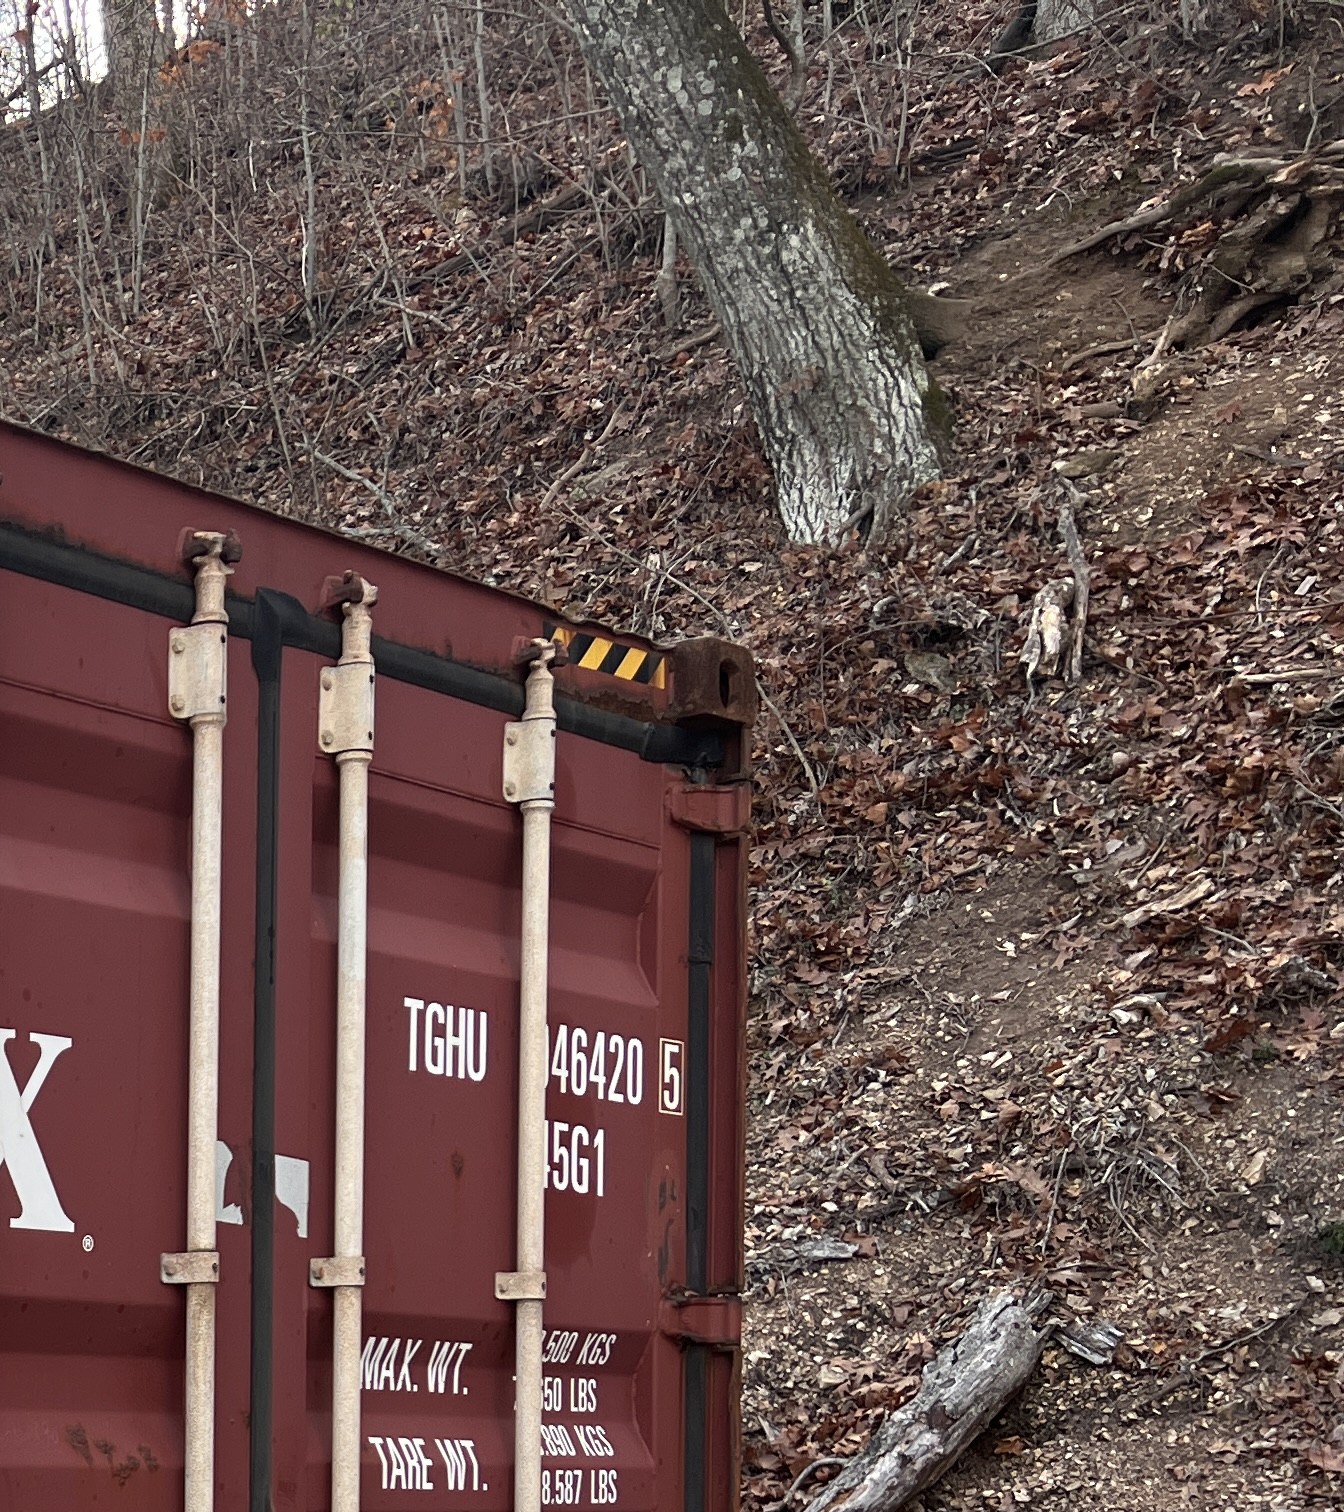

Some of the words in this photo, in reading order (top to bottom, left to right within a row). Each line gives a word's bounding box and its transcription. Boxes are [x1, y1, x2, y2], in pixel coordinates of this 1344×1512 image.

[404, 996, 488, 1082] TGHU
[544, 1023, 643, 1105] 46420
[663, 1043, 680, 1110] 5
[360, 1336, 419, 1392] MAX.
[427, 1341, 473, 1395] WT.
[576, 1332, 617, 1365] KGS
[570, 1378, 597, 1412] LBS
[368, 1436, 434, 1491] TARE
[434, 1438, 489, 1491] WT.
[574, 1425, 614, 1457] KGS
[590, 1469, 618, 1504] LBS
